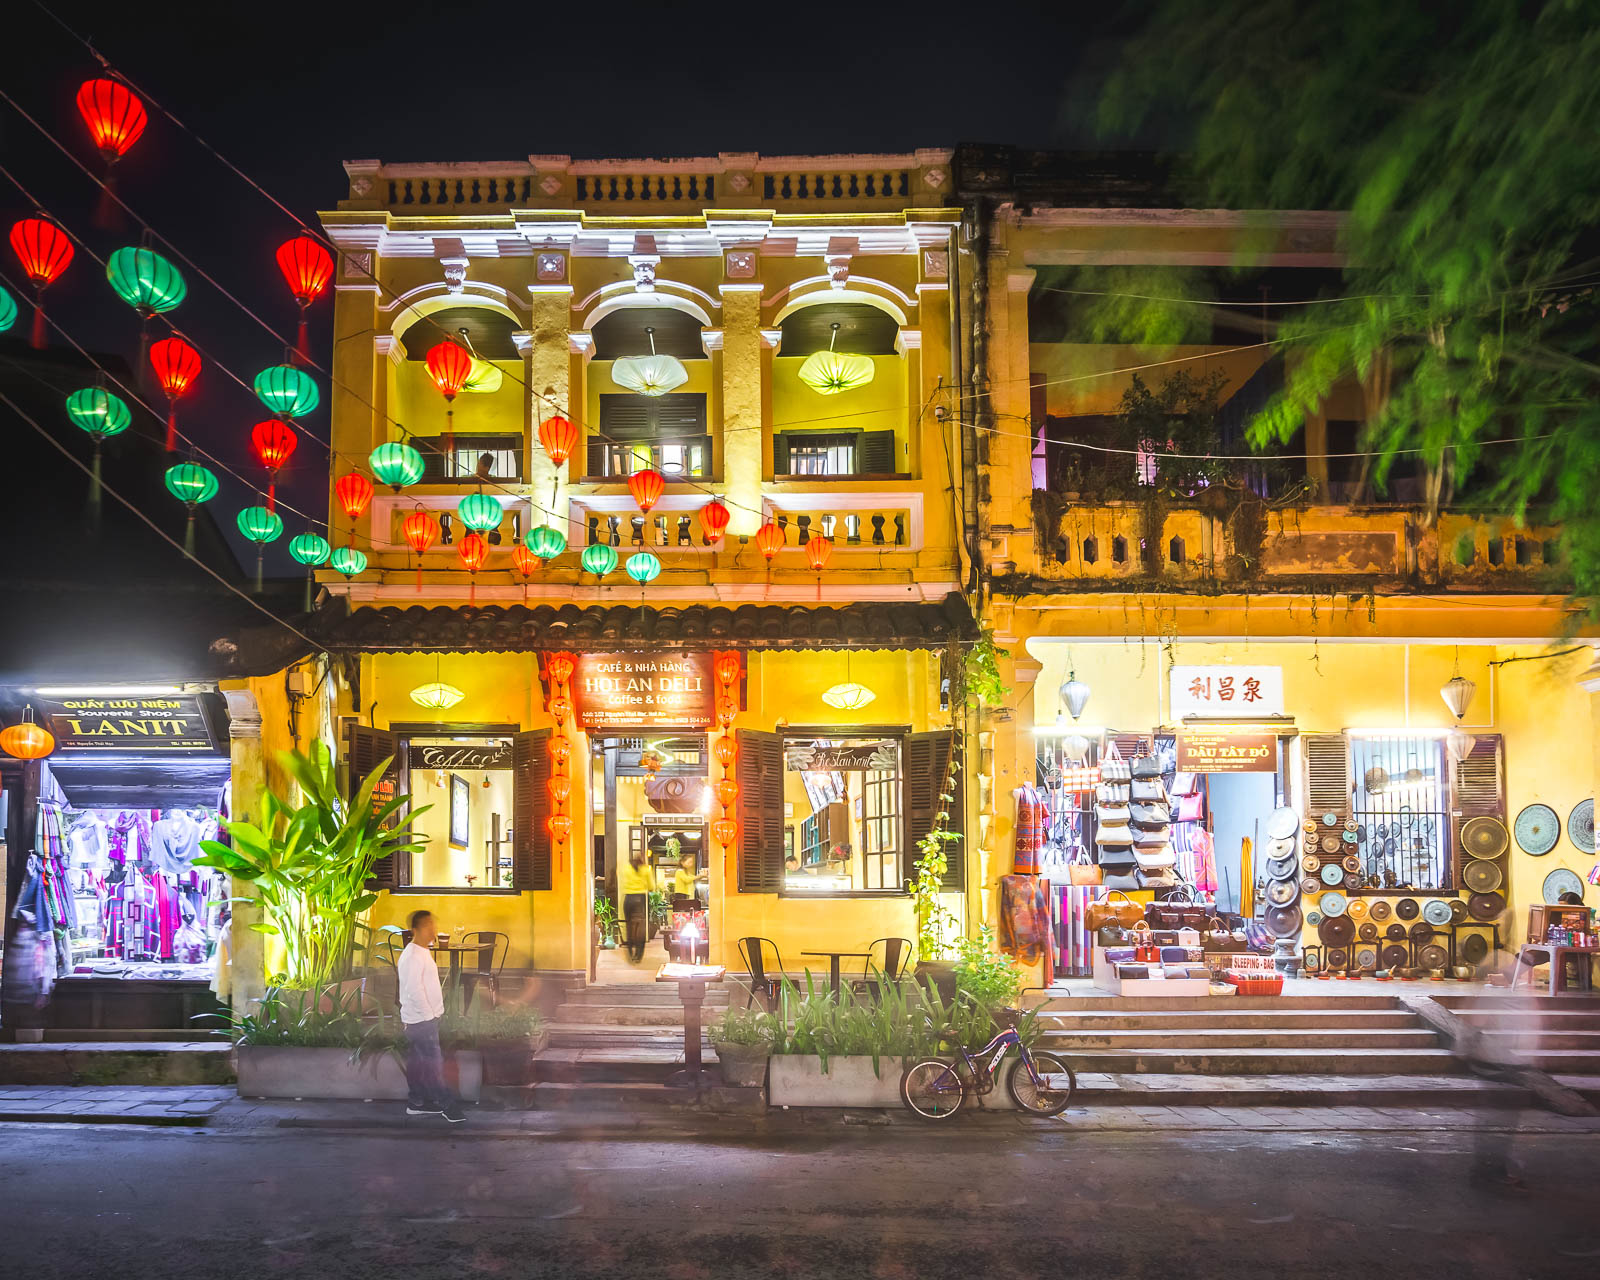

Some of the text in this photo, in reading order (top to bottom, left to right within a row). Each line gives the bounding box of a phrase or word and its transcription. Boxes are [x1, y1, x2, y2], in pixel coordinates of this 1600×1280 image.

[597, 661, 691, 672] CAFÉ & NHÀ HÀNG
[586, 678, 702, 692] HOI AN DELI
[1188, 676, 1263, 702] 利昌泉
[139, 710, 172, 718] Shop
[66, 719, 188, 736] LANIT
[1234, 957, 1259, 969] SLEEPING
[1263, 958, 1274, 969] BAG
